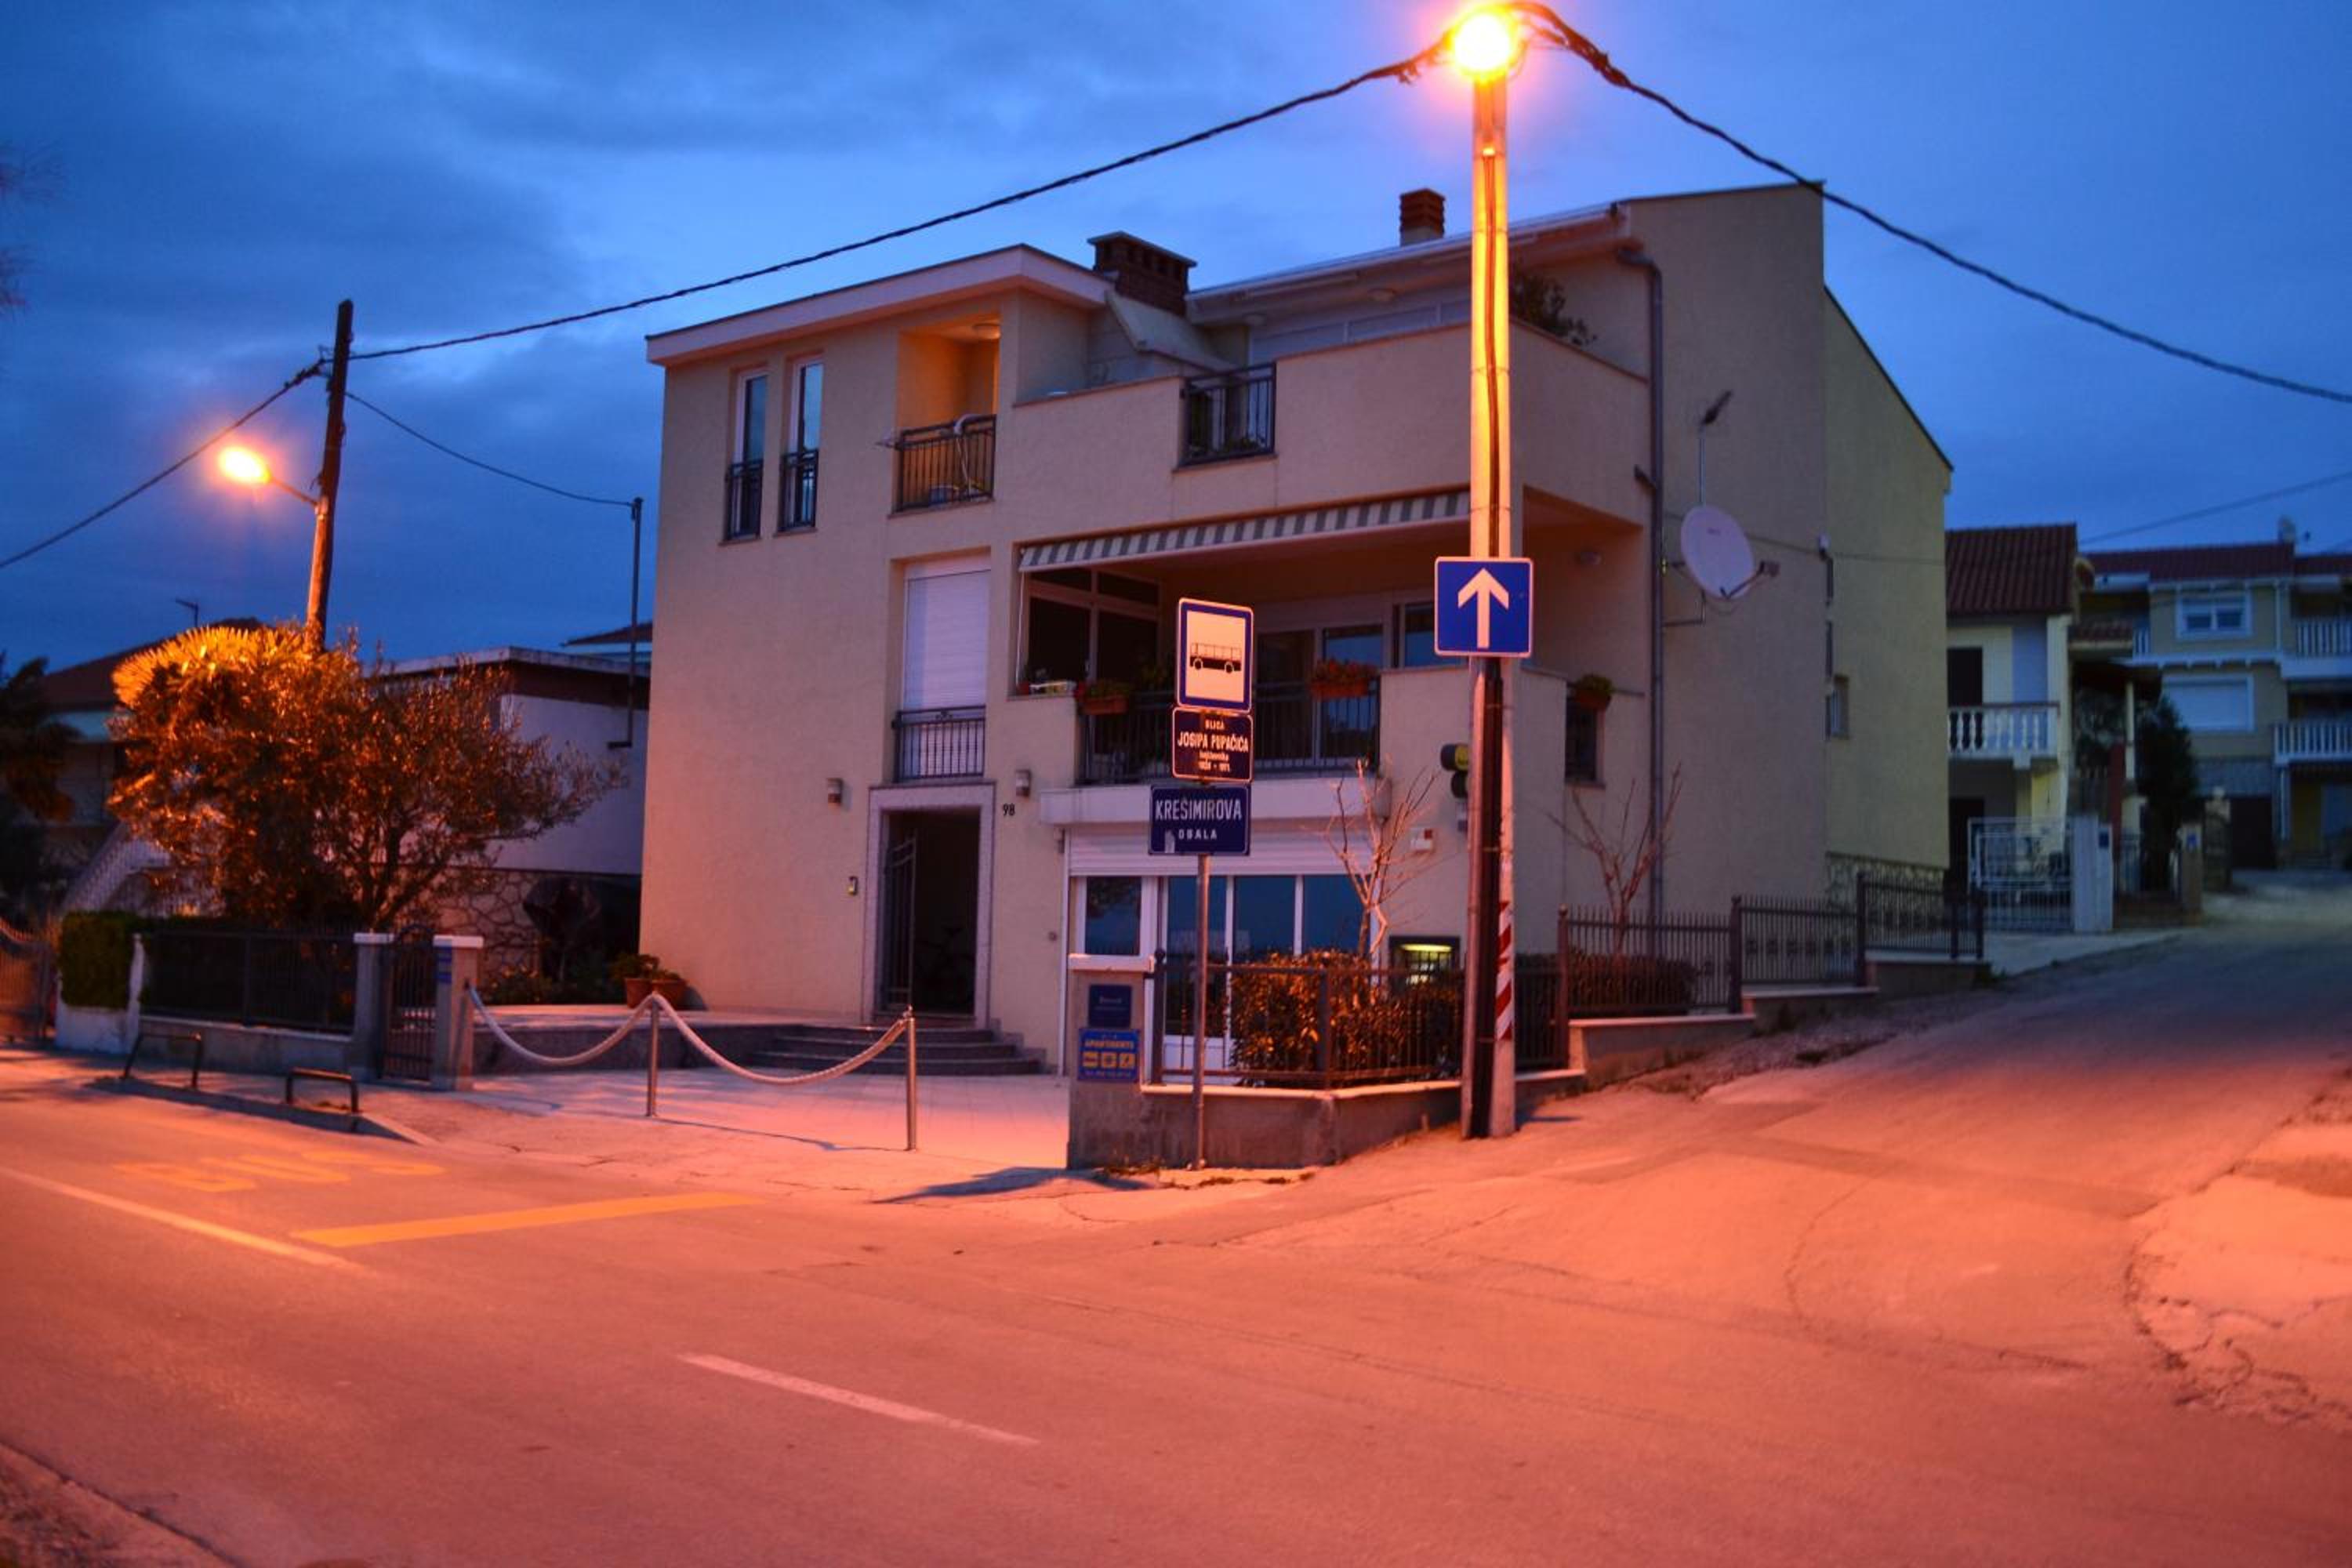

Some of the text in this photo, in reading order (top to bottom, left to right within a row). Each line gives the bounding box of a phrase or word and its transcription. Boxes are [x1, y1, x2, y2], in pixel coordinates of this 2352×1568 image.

[1178, 731, 1208, 749] JOSIPA
[1004, 803, 1015, 816] 98
[1178, 829, 1218, 840] OBALA
